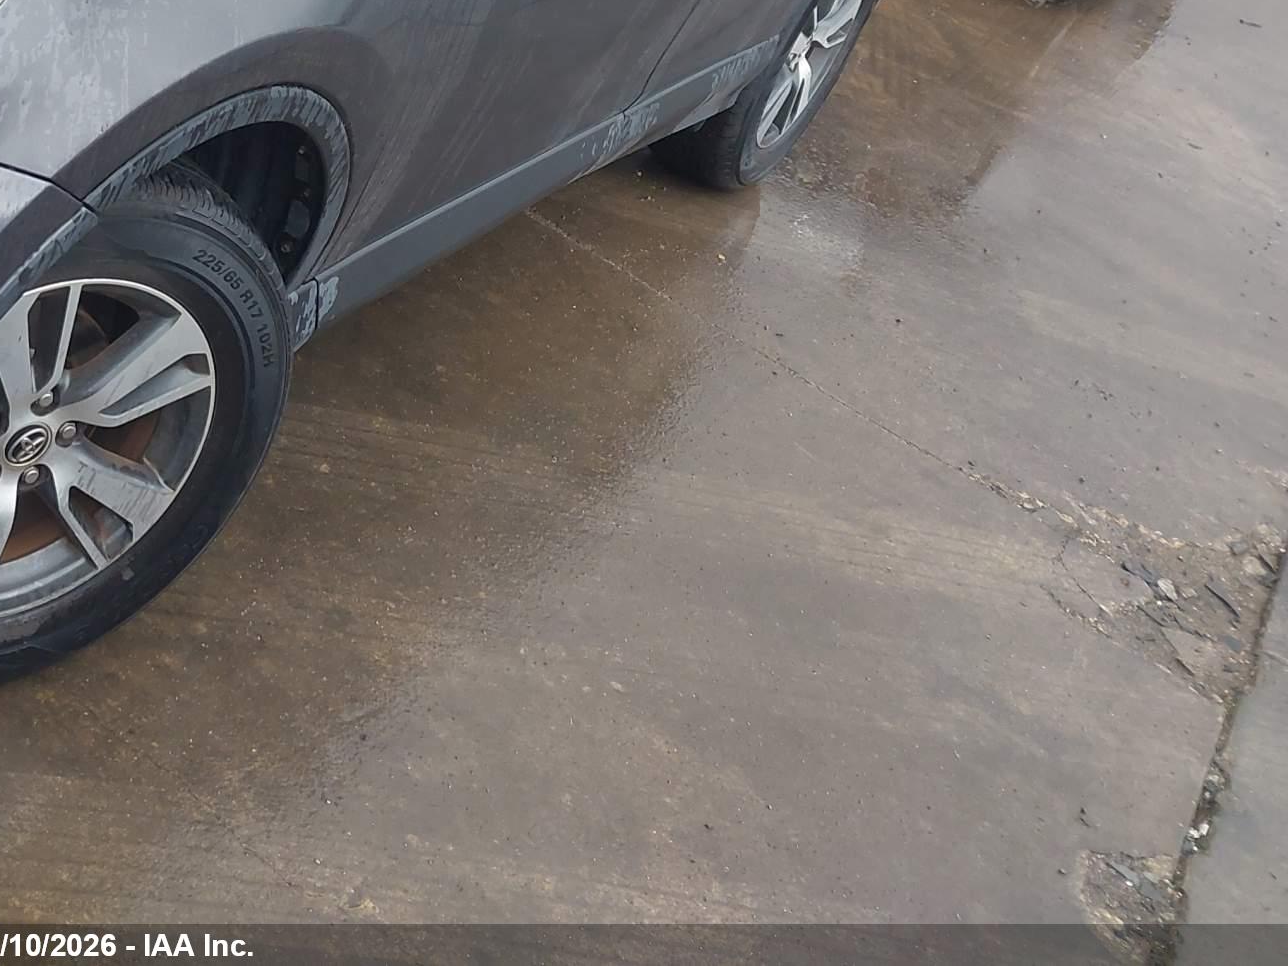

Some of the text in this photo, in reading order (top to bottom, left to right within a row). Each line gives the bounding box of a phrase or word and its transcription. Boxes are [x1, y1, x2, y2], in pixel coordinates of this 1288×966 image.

[192, 249, 276, 368] 225/65 R17 102H
